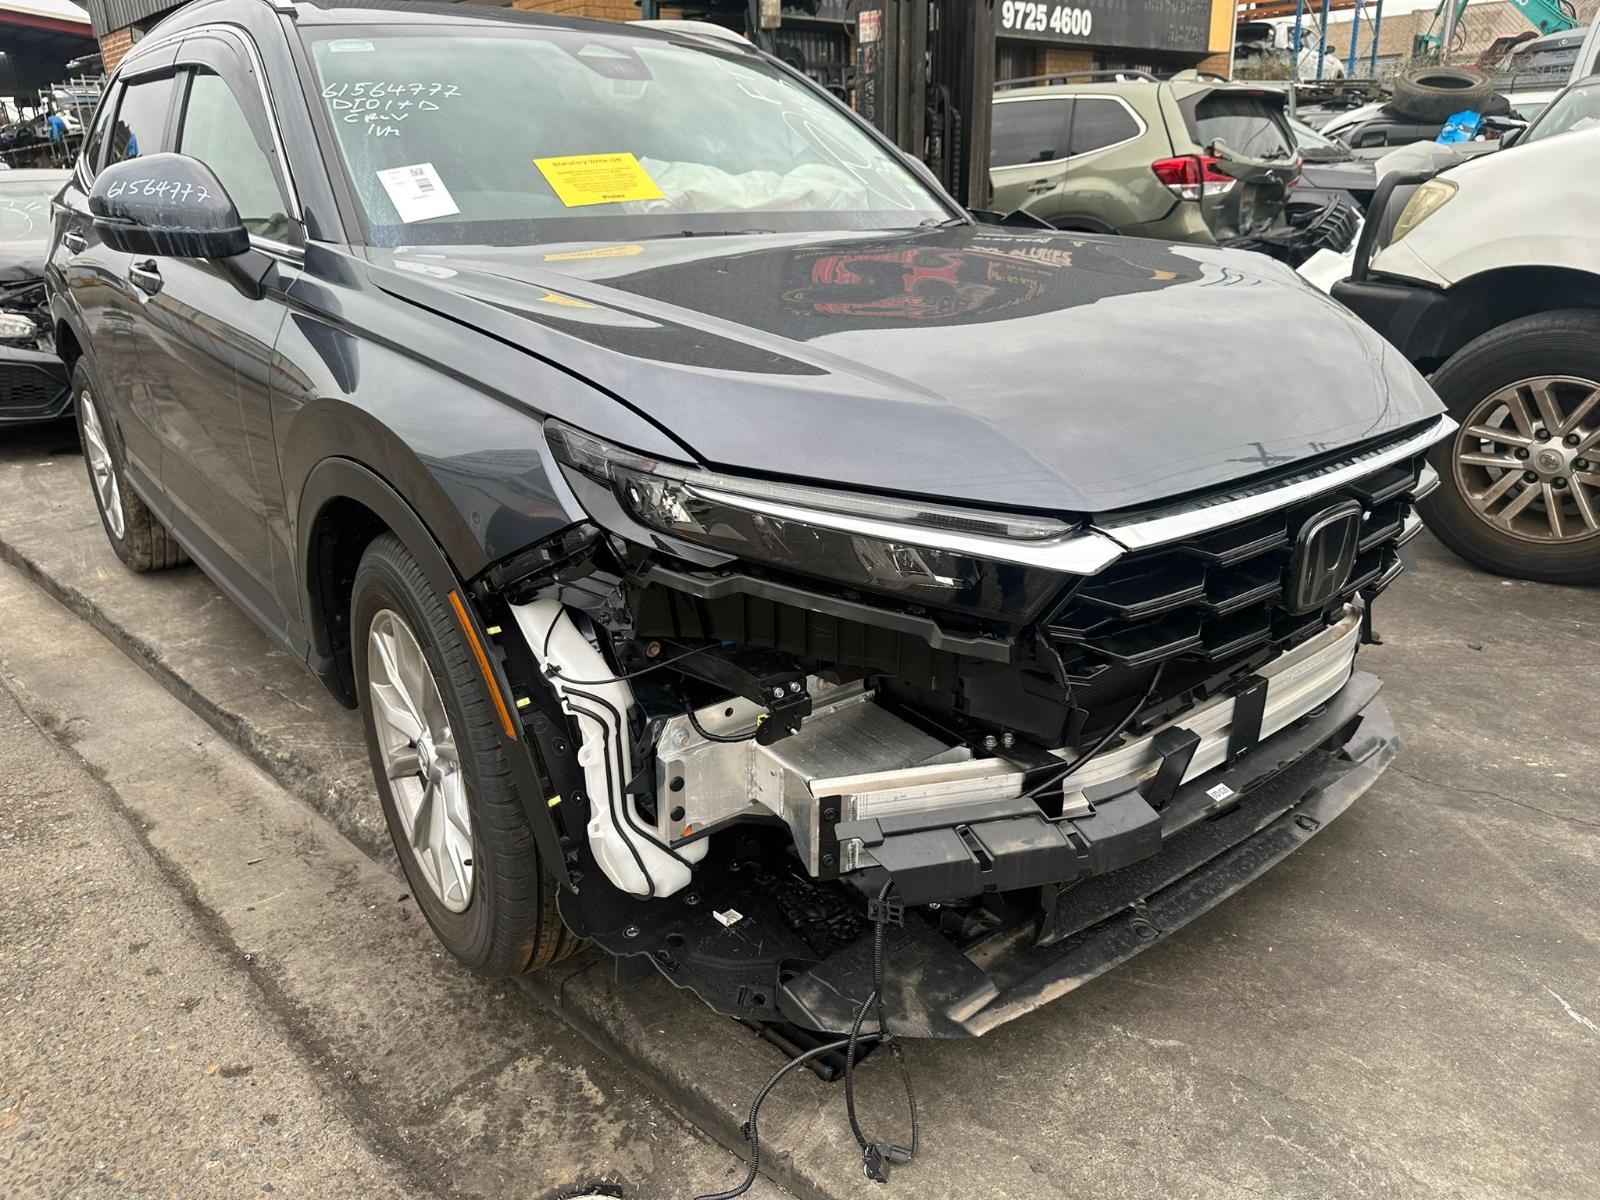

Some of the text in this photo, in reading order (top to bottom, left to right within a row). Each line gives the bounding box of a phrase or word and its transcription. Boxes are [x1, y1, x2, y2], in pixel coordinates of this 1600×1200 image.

[1001, 0, 1093, 37] 9725 4600
[106, 178, 212, 203] 61564777
